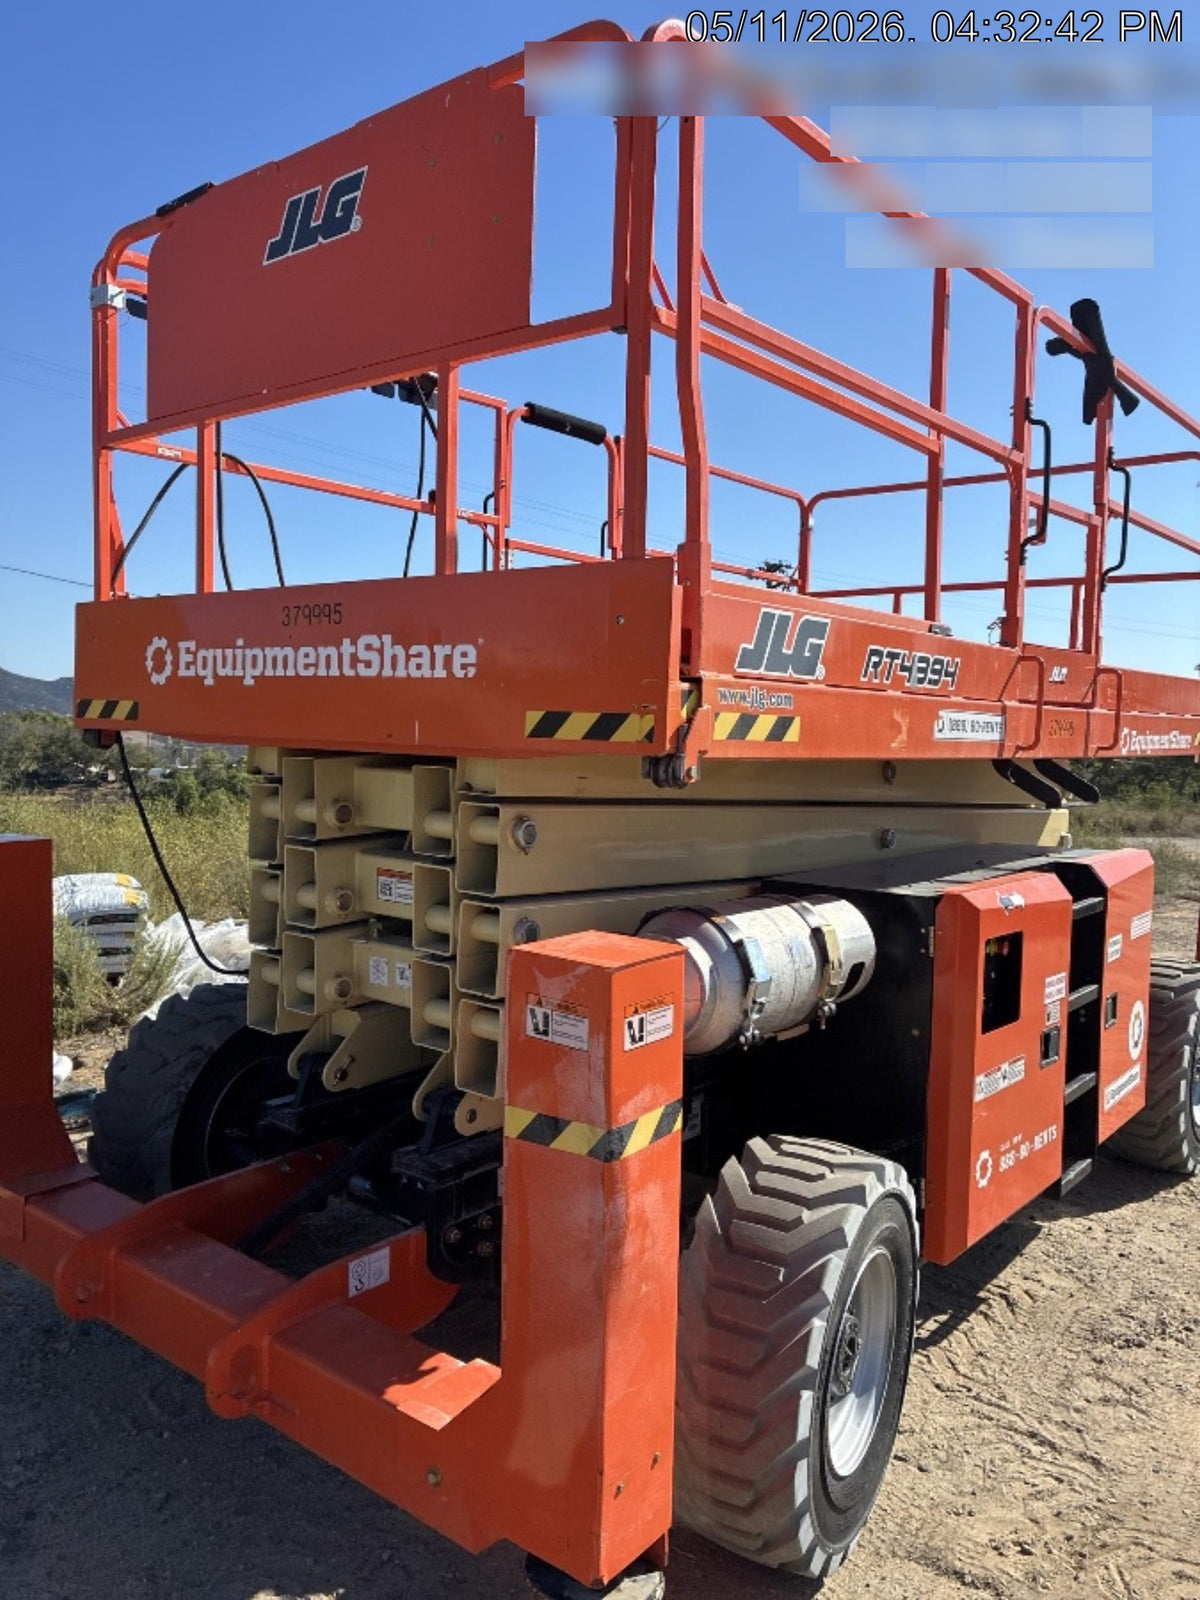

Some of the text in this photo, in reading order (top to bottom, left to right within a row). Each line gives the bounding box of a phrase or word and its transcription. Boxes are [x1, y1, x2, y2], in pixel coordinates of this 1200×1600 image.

[263, 165, 368, 266] JLG
[282, 602, 342, 626] 379995
[176, 634, 478, 685] EquipmentShare
[734, 607, 830, 679] JLG
[717, 686, 793, 711] www.jlg.com
